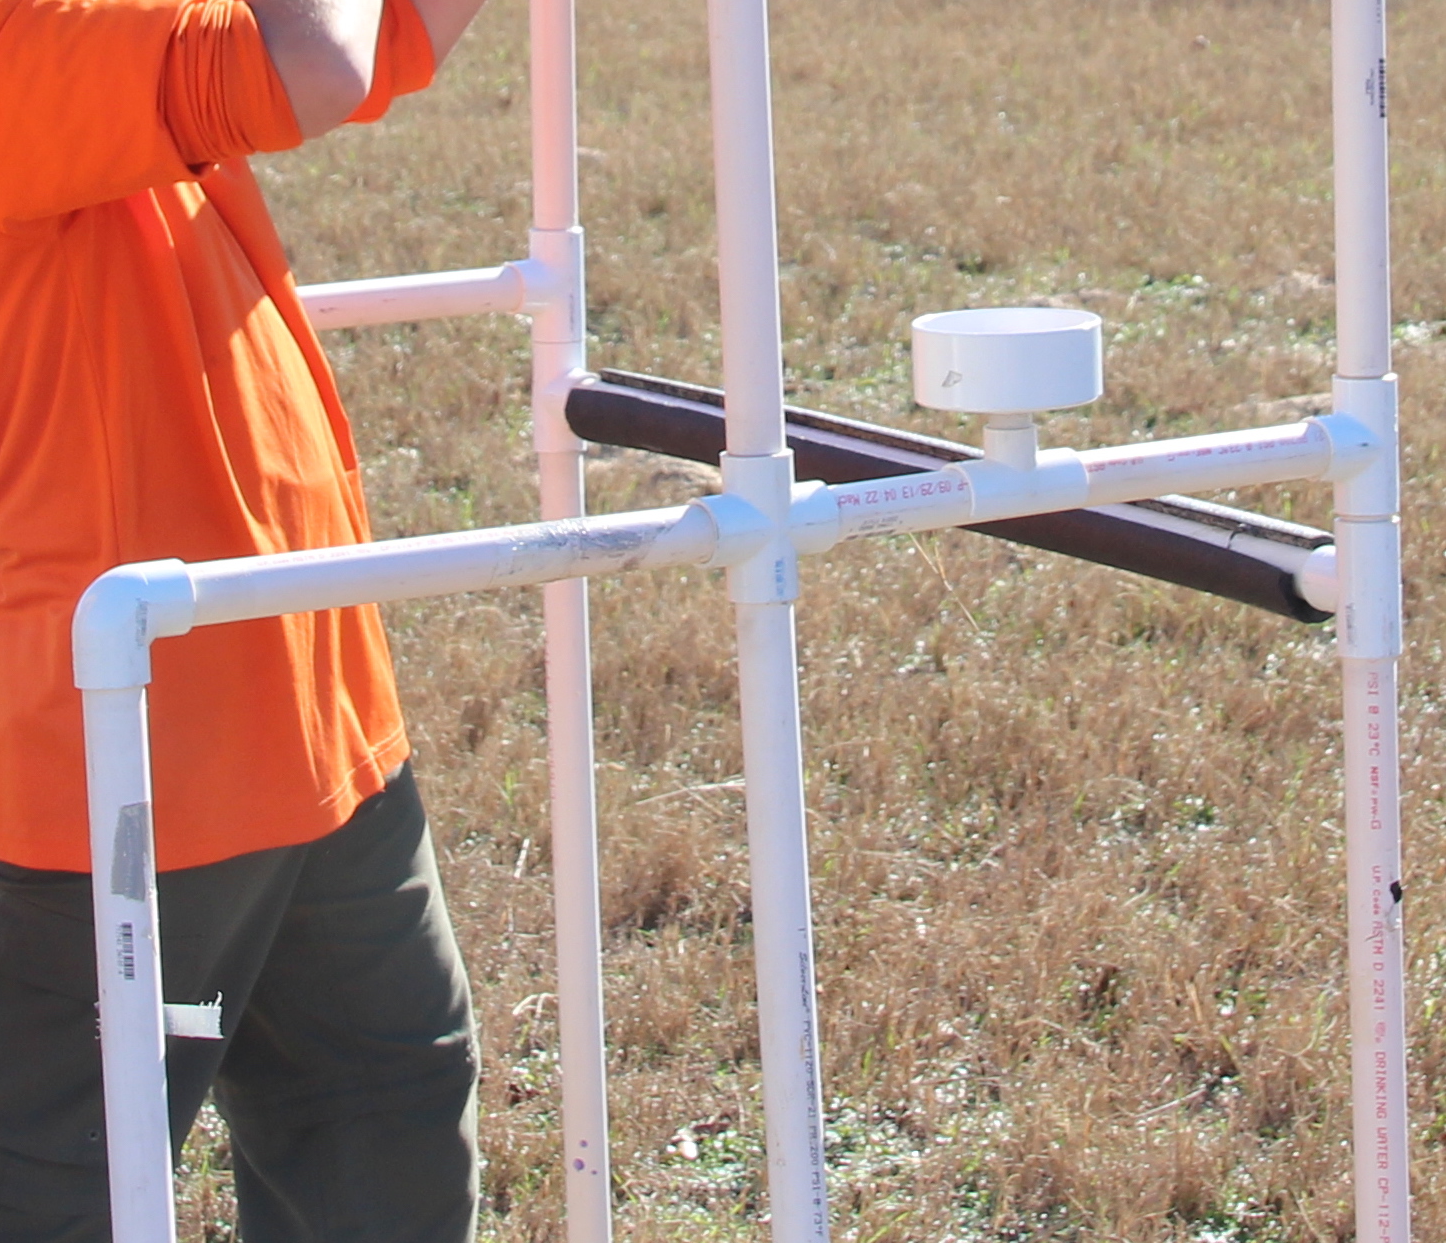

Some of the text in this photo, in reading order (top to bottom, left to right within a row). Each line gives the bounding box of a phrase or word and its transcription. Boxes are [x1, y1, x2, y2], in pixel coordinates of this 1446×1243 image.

[1373, 979, 1385, 1010] 2241
[1374, 1051, 1388, 1119] DRINKING
[1376, 1127, 1389, 1170] WATER
